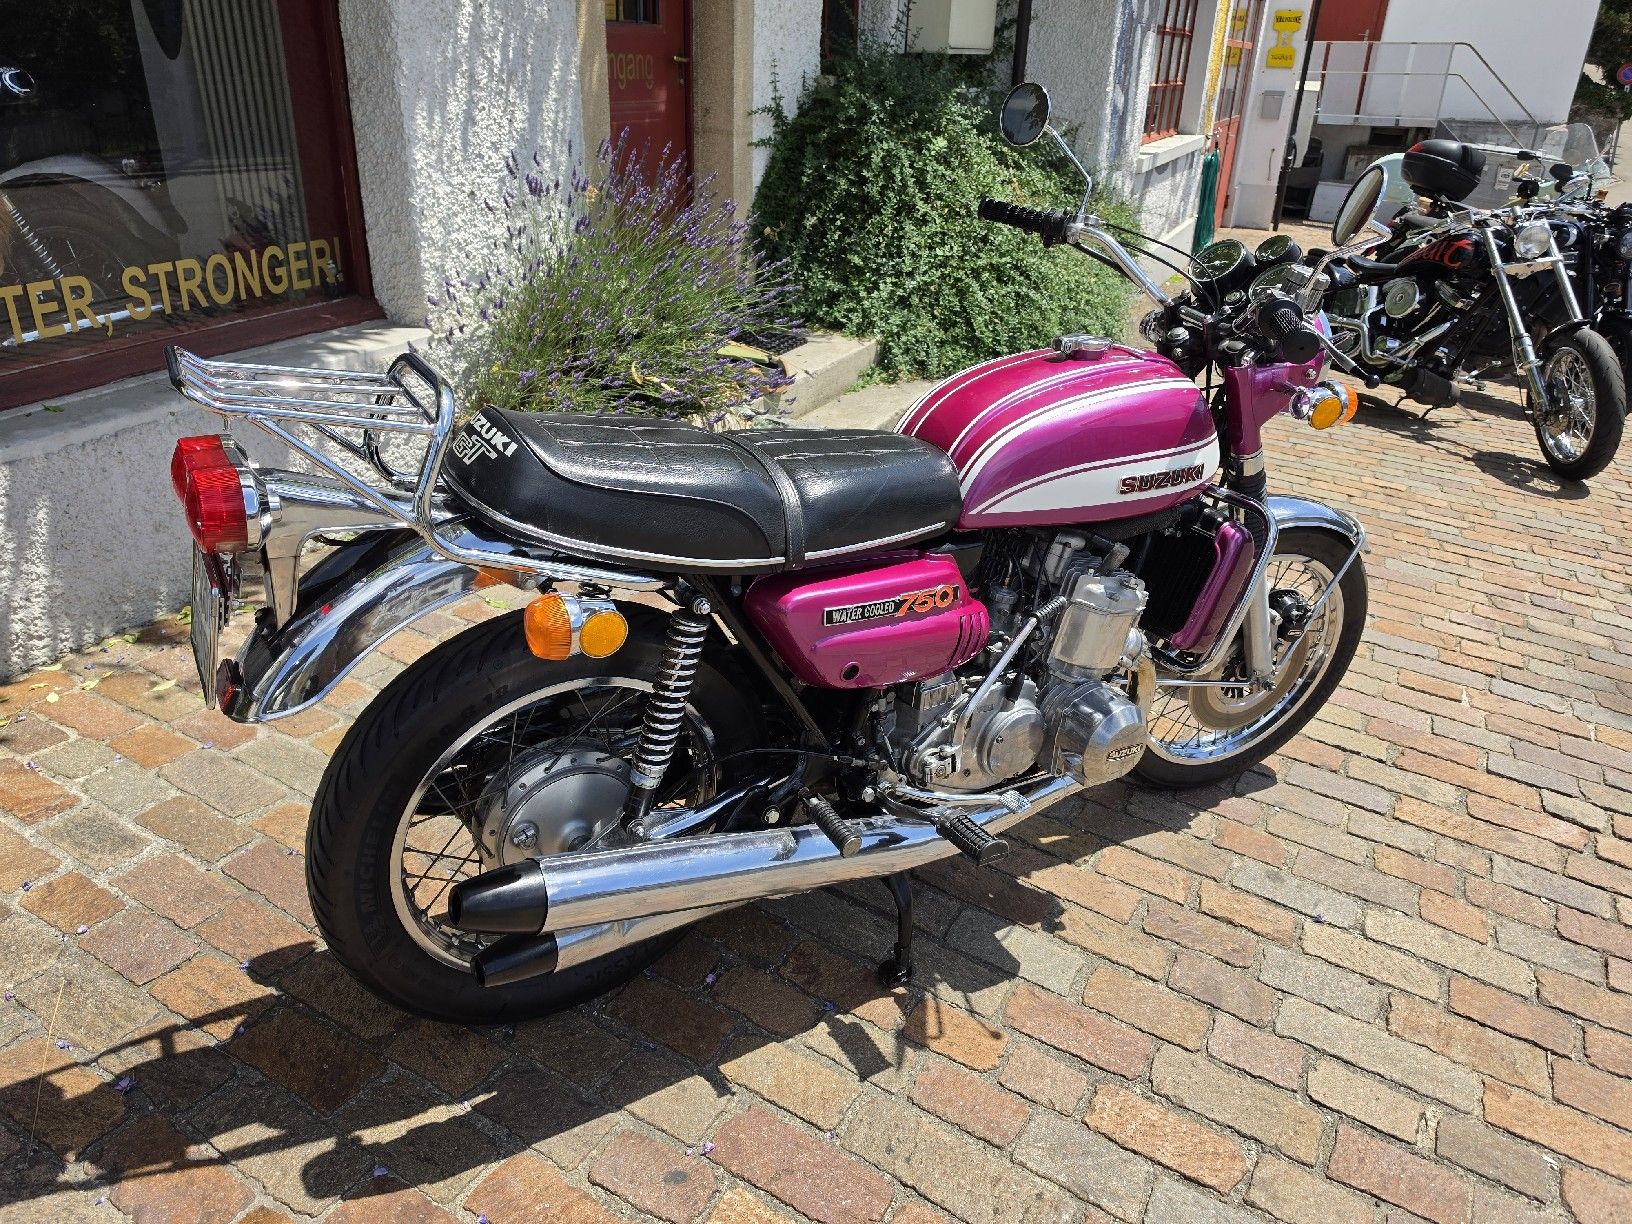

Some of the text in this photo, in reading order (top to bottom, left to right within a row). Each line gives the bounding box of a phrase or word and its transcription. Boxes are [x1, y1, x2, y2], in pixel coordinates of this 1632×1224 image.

[121, 236, 345, 321] STRONGER!
[452, 431, 498, 466] GT
[1118, 462, 1205, 495] SUZUKI
[832, 584, 954, 623] WATER COOLED 750
[1107, 742, 1144, 760] SUZUKI
